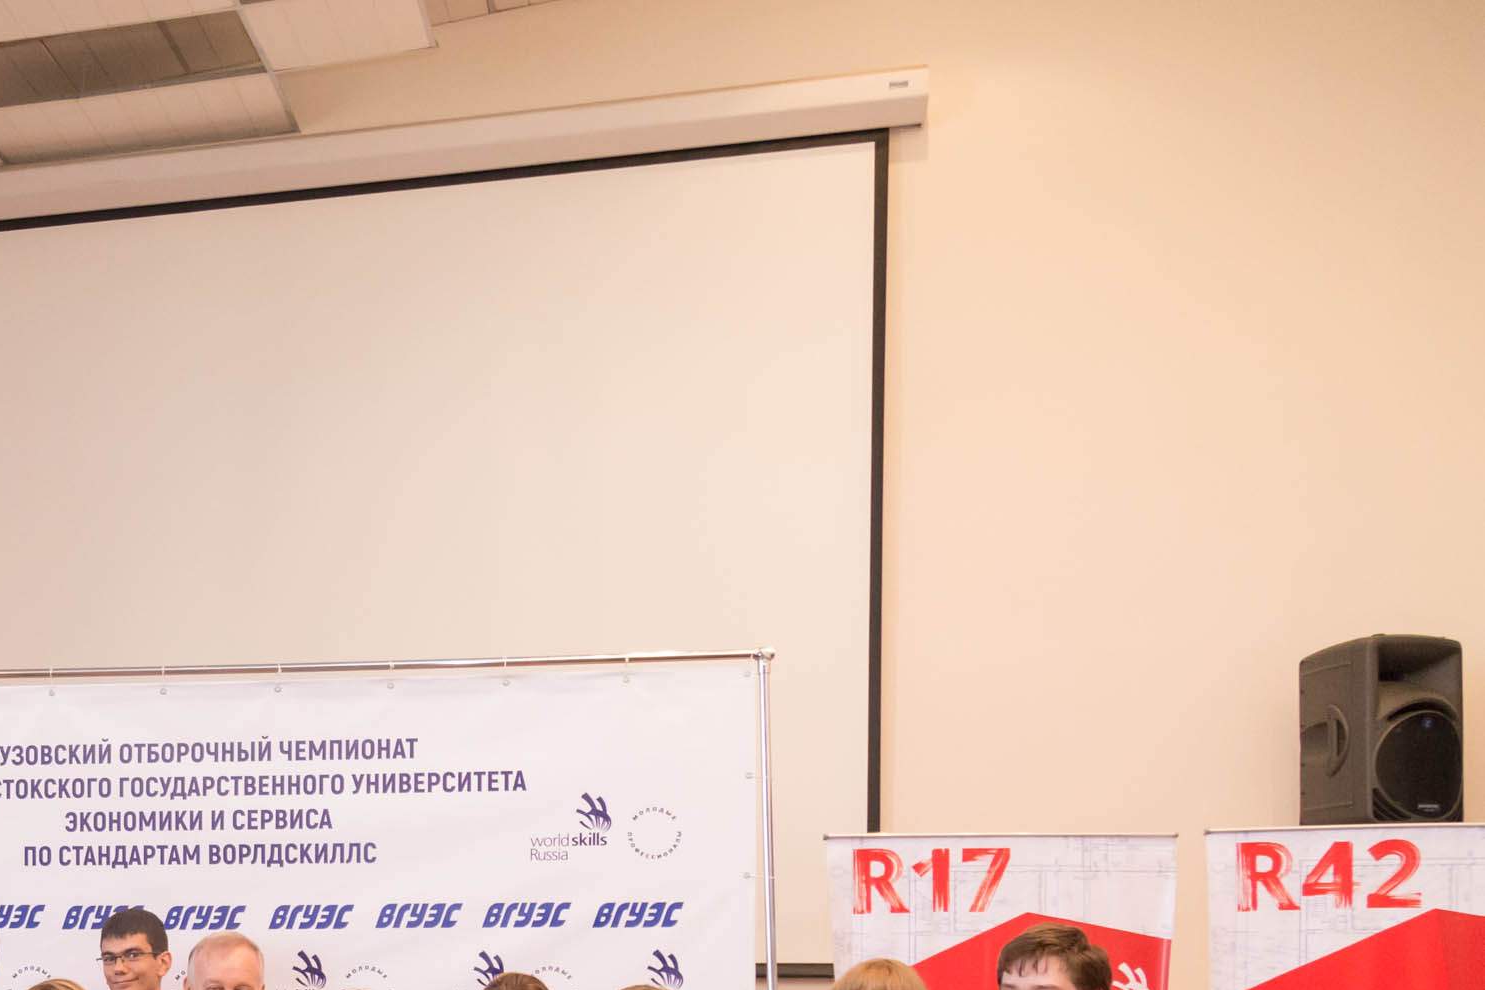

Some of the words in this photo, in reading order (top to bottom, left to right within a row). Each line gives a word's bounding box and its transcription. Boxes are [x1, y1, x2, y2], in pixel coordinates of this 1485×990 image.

[119, 736, 272, 764] ОТБОРОЧНЫЙ
[279, 738, 418, 762] ЧЕМПИОНАТ
[119, 774, 344, 800] ГОСУДАРСТВЕННОГО
[352, 770, 527, 795] УНИВЕРСИТЕТА
[65, 810, 203, 832] ЭКОНОМИКИ
[211, 810, 224, 830] И
[232, 809, 333, 830] СЕРВИСА
[23, 846, 52, 866] ПО
[58, 845, 201, 869] СТАНДАРТАМ
[208, 842, 377, 867] ВОРЛДСКИЛЛС
[530, 849, 569, 861] Russia
[852, 847, 1011, 914] R17
[1236, 839, 1423, 912] R42
[164, 905, 246, 930] ВГУЭС
[268, 904, 354, 930] ВГУЭС
[375, 903, 463, 928] ВГУЭС
[482, 902, 571, 928] ВГУЭС
[592, 901, 683, 928] ВГУЭС
